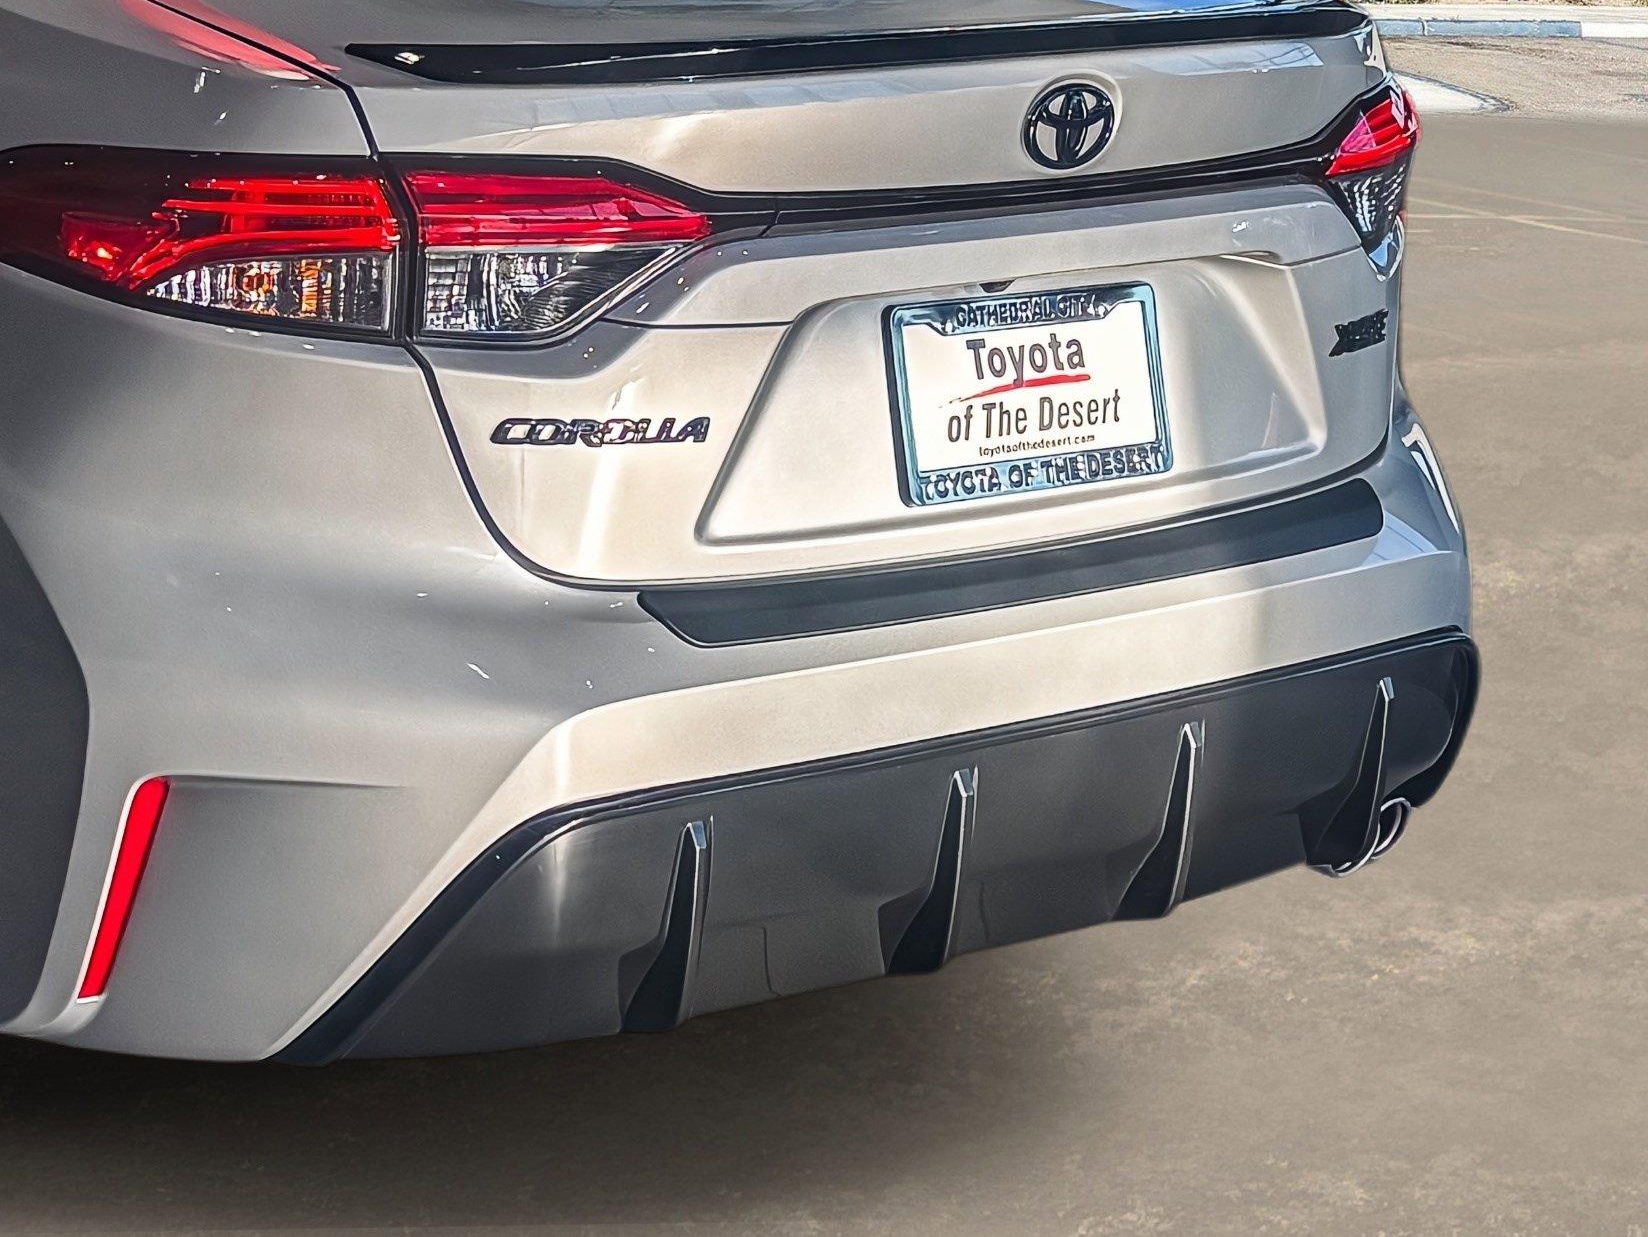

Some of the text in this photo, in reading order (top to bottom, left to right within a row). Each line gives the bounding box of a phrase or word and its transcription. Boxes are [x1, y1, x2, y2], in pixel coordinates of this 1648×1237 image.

[966, 333, 1086, 389] Toyota
[490, 416, 711, 448] COROLLA
[947, 389, 1121, 443] of The Desert
[920, 443, 1165, 501] TOYOTA OF THE DESERT
